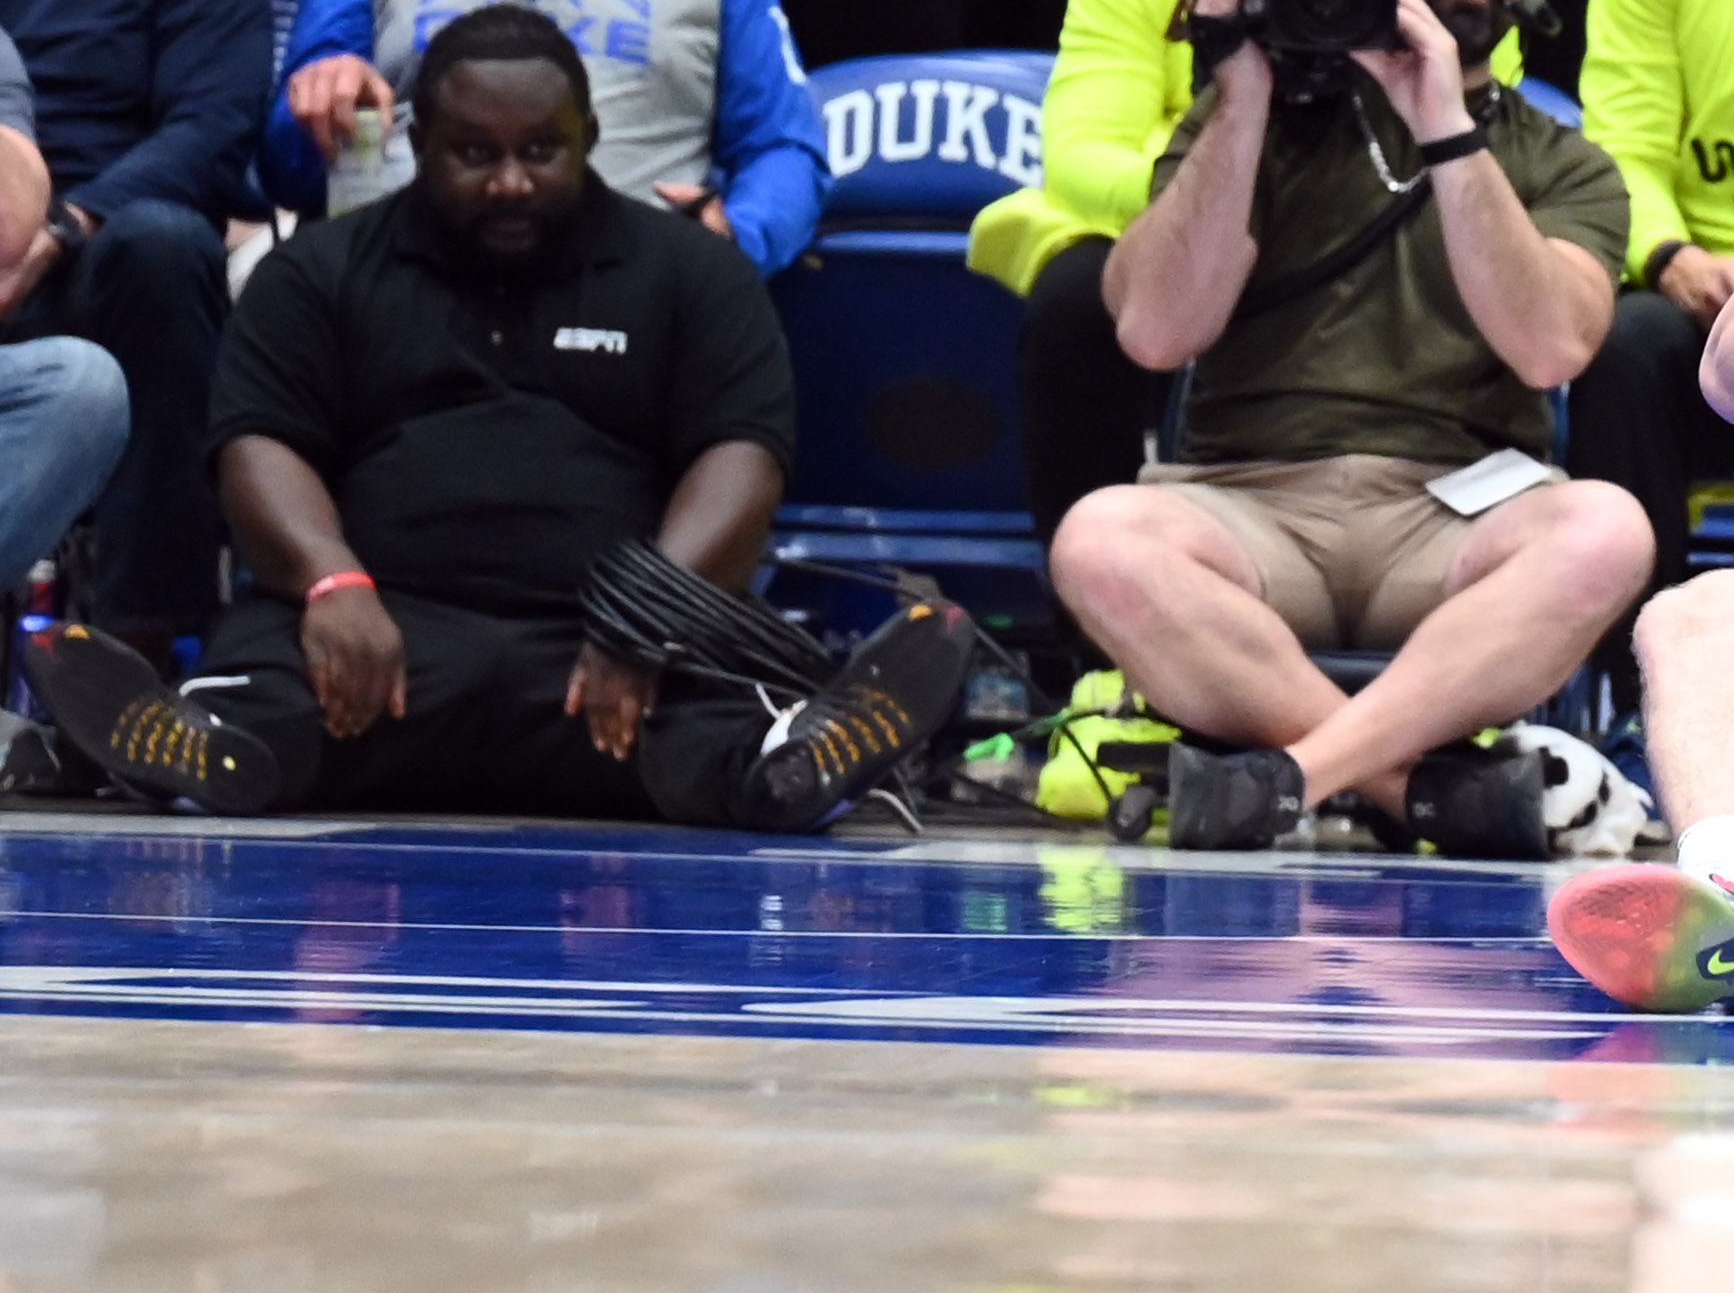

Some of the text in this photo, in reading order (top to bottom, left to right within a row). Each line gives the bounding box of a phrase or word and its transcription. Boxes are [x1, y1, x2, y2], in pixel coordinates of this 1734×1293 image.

[413, 9, 652, 64] DKE
[822, 79, 1044, 190] DUKE
[553, 326, 629, 356] ESPN
